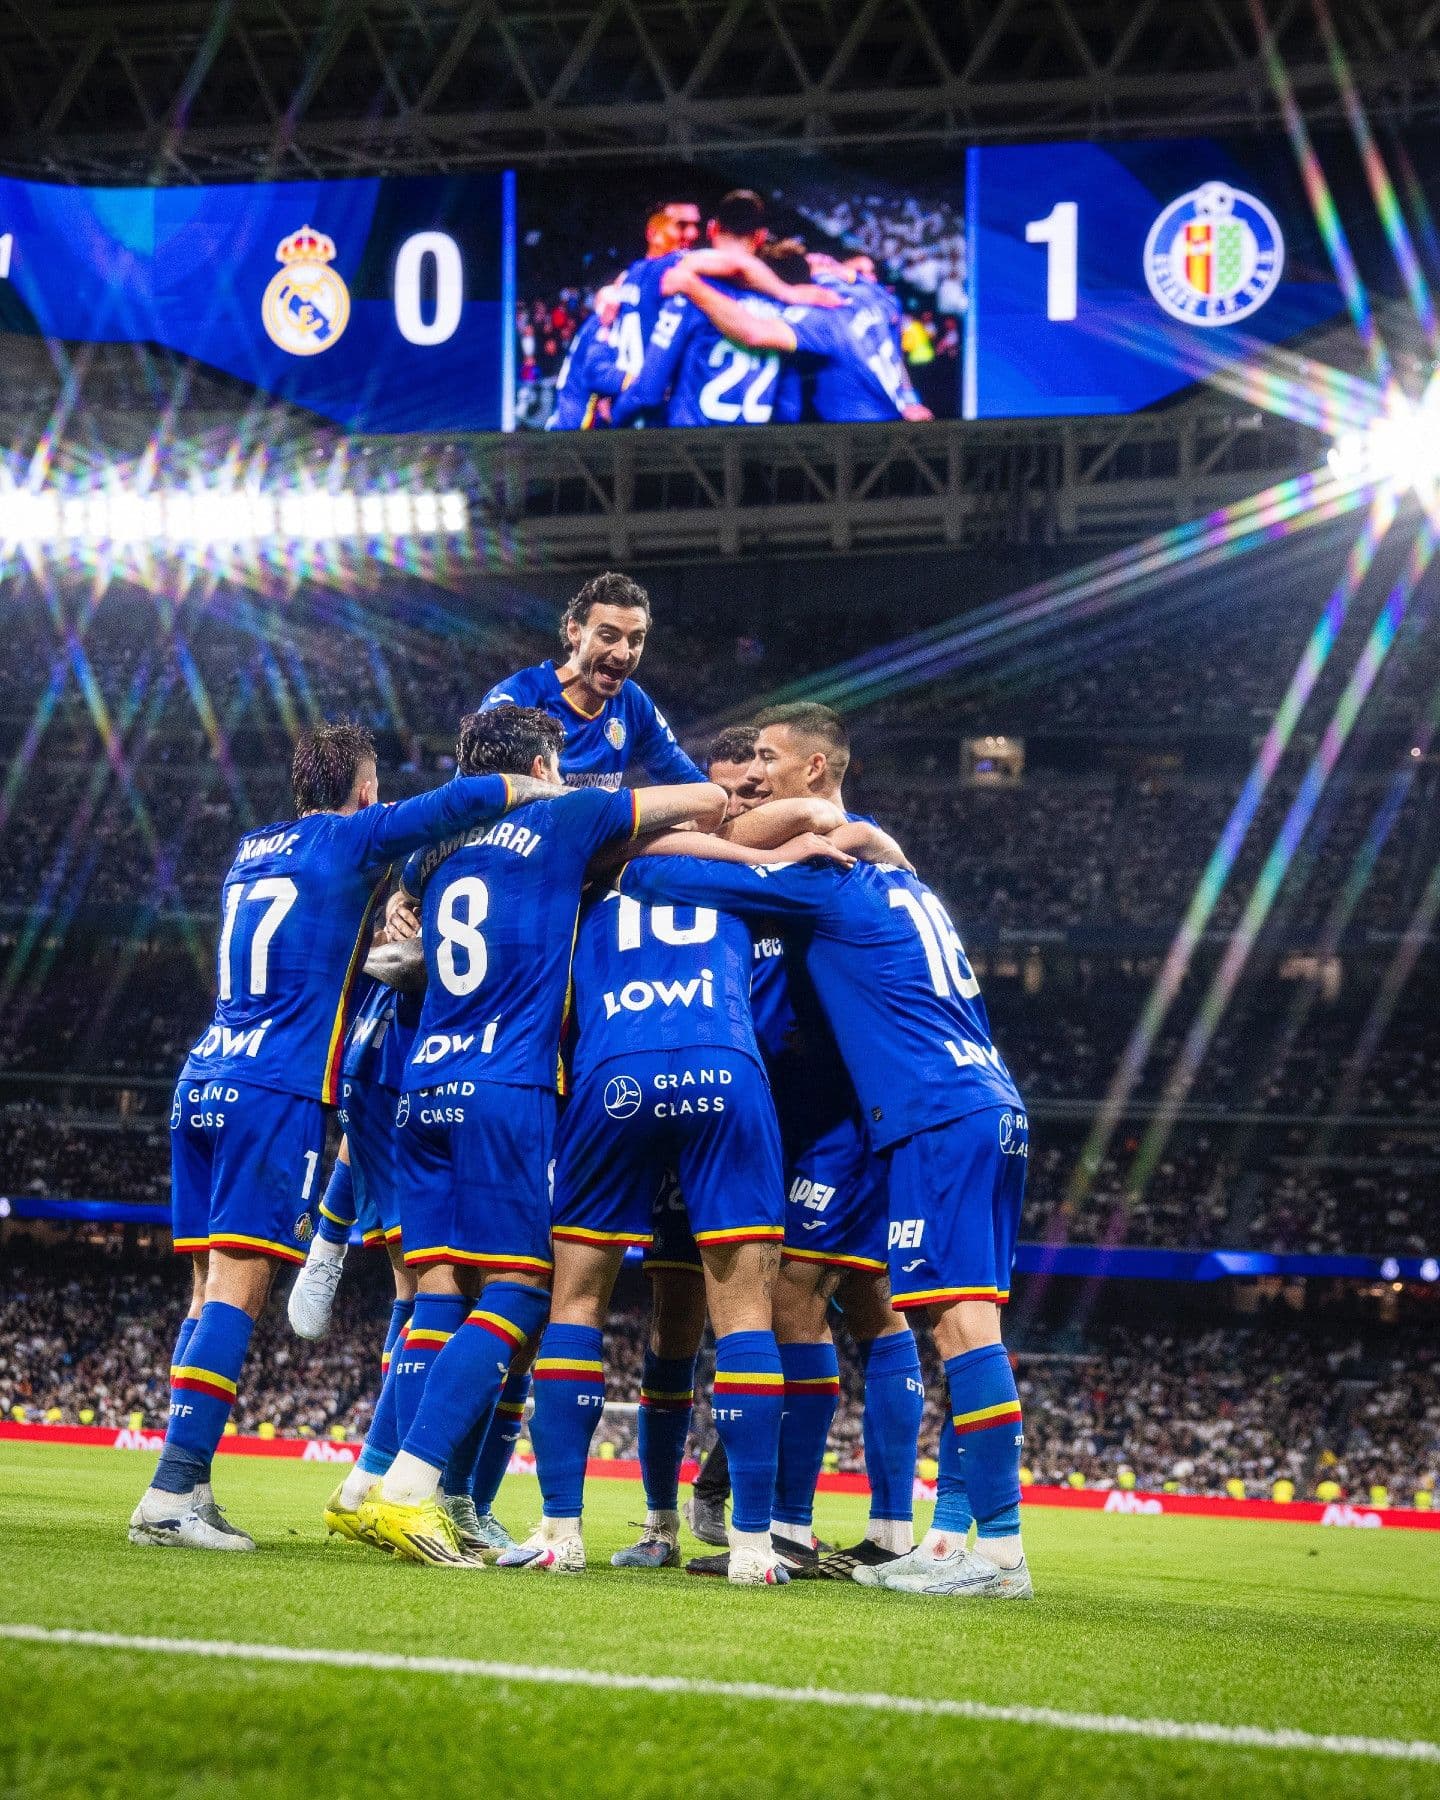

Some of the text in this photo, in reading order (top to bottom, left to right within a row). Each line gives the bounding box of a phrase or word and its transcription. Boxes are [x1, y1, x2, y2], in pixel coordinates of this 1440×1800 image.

[394, 231, 464, 346] 0
[1026, 201, 1079, 321] 1
[220, 877, 299, 1000] 17
[437, 876, 489, 996] 8
[888, 888, 981, 1000] 16
[653, 1069, 732, 1090] GRAND
[653, 1097, 725, 1118] CLASS
